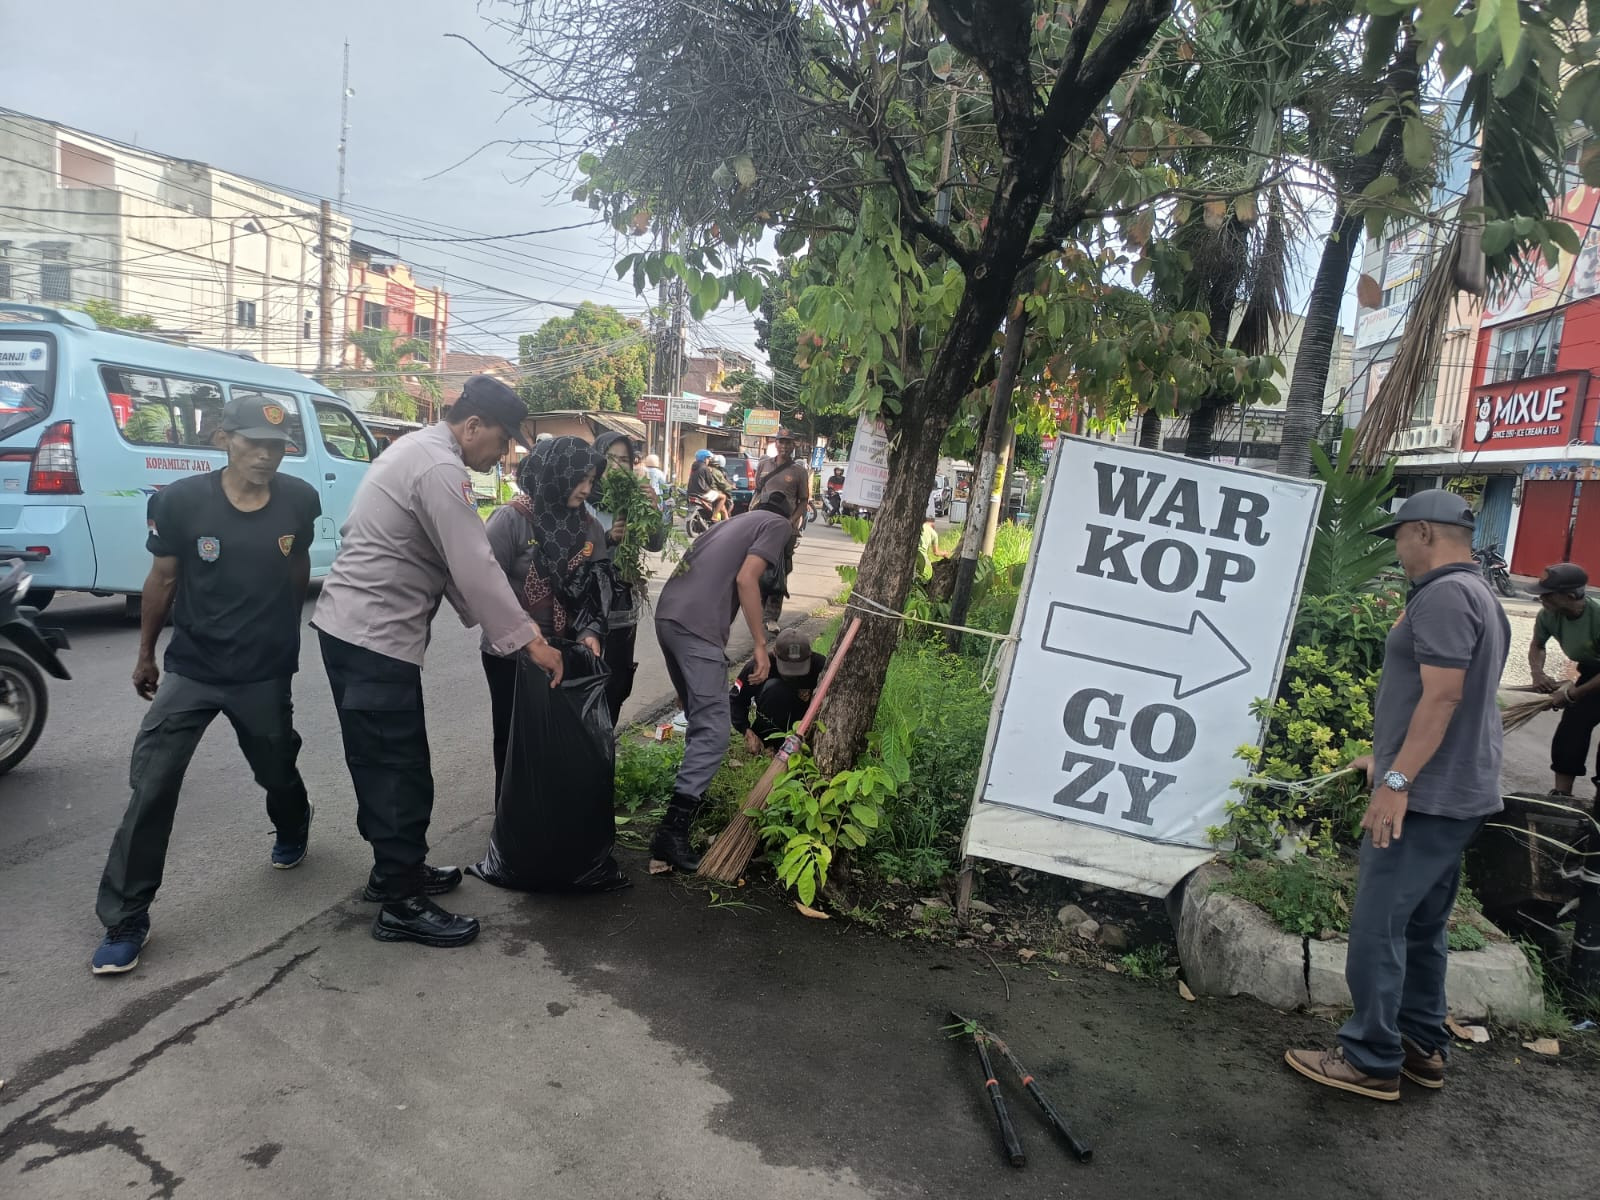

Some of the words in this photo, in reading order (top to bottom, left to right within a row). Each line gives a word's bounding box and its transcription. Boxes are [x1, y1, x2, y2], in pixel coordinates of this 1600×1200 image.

[1493, 386, 1566, 426] MIXUE
[1525, 427, 1543, 436] CREAM
[1548, 425, 1560, 435] TEA
[146, 457, 190, 471] KOPAMILET
[192, 459, 211, 472] JAYA
[1093, 461, 1270, 547] WAR
[1076, 523, 1256, 603] KOP
[1062, 687, 1197, 763] GO
[1053, 750, 1177, 826] ZY
